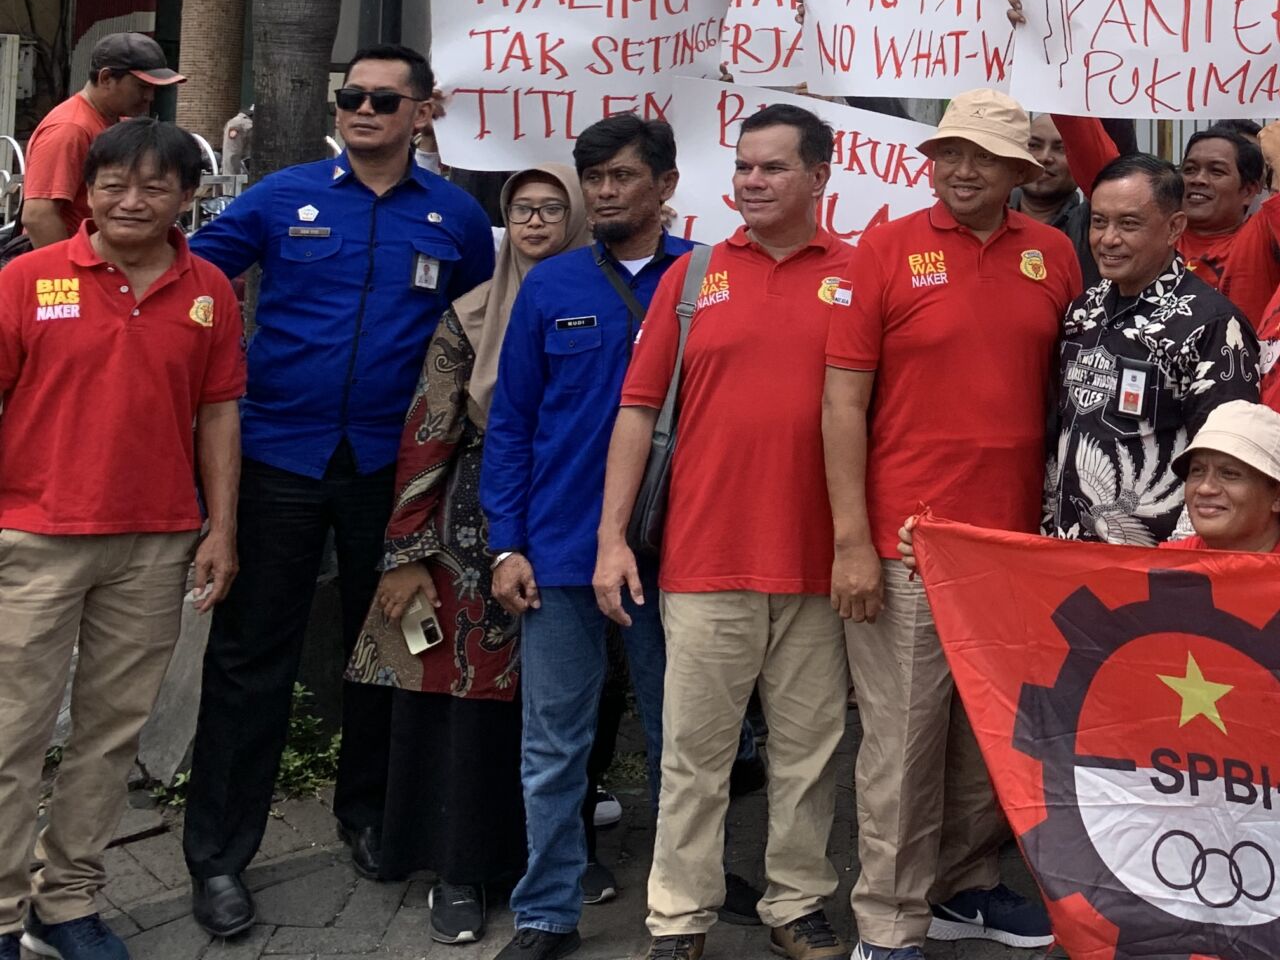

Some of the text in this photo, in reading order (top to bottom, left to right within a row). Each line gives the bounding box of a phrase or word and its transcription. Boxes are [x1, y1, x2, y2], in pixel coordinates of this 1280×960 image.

[469, 26, 568, 80] TAK
[817, 20, 1013, 82] NO WHAT-W
[909, 250, 945, 266] BIN
[911, 262, 946, 276] WAS
[36, 278, 79, 293] BIN
[912, 272, 949, 289] NAKER
[37, 291, 79, 306] WAS
[37, 305, 80, 321] NAKER
[1149, 747, 1272, 811] SPBI
